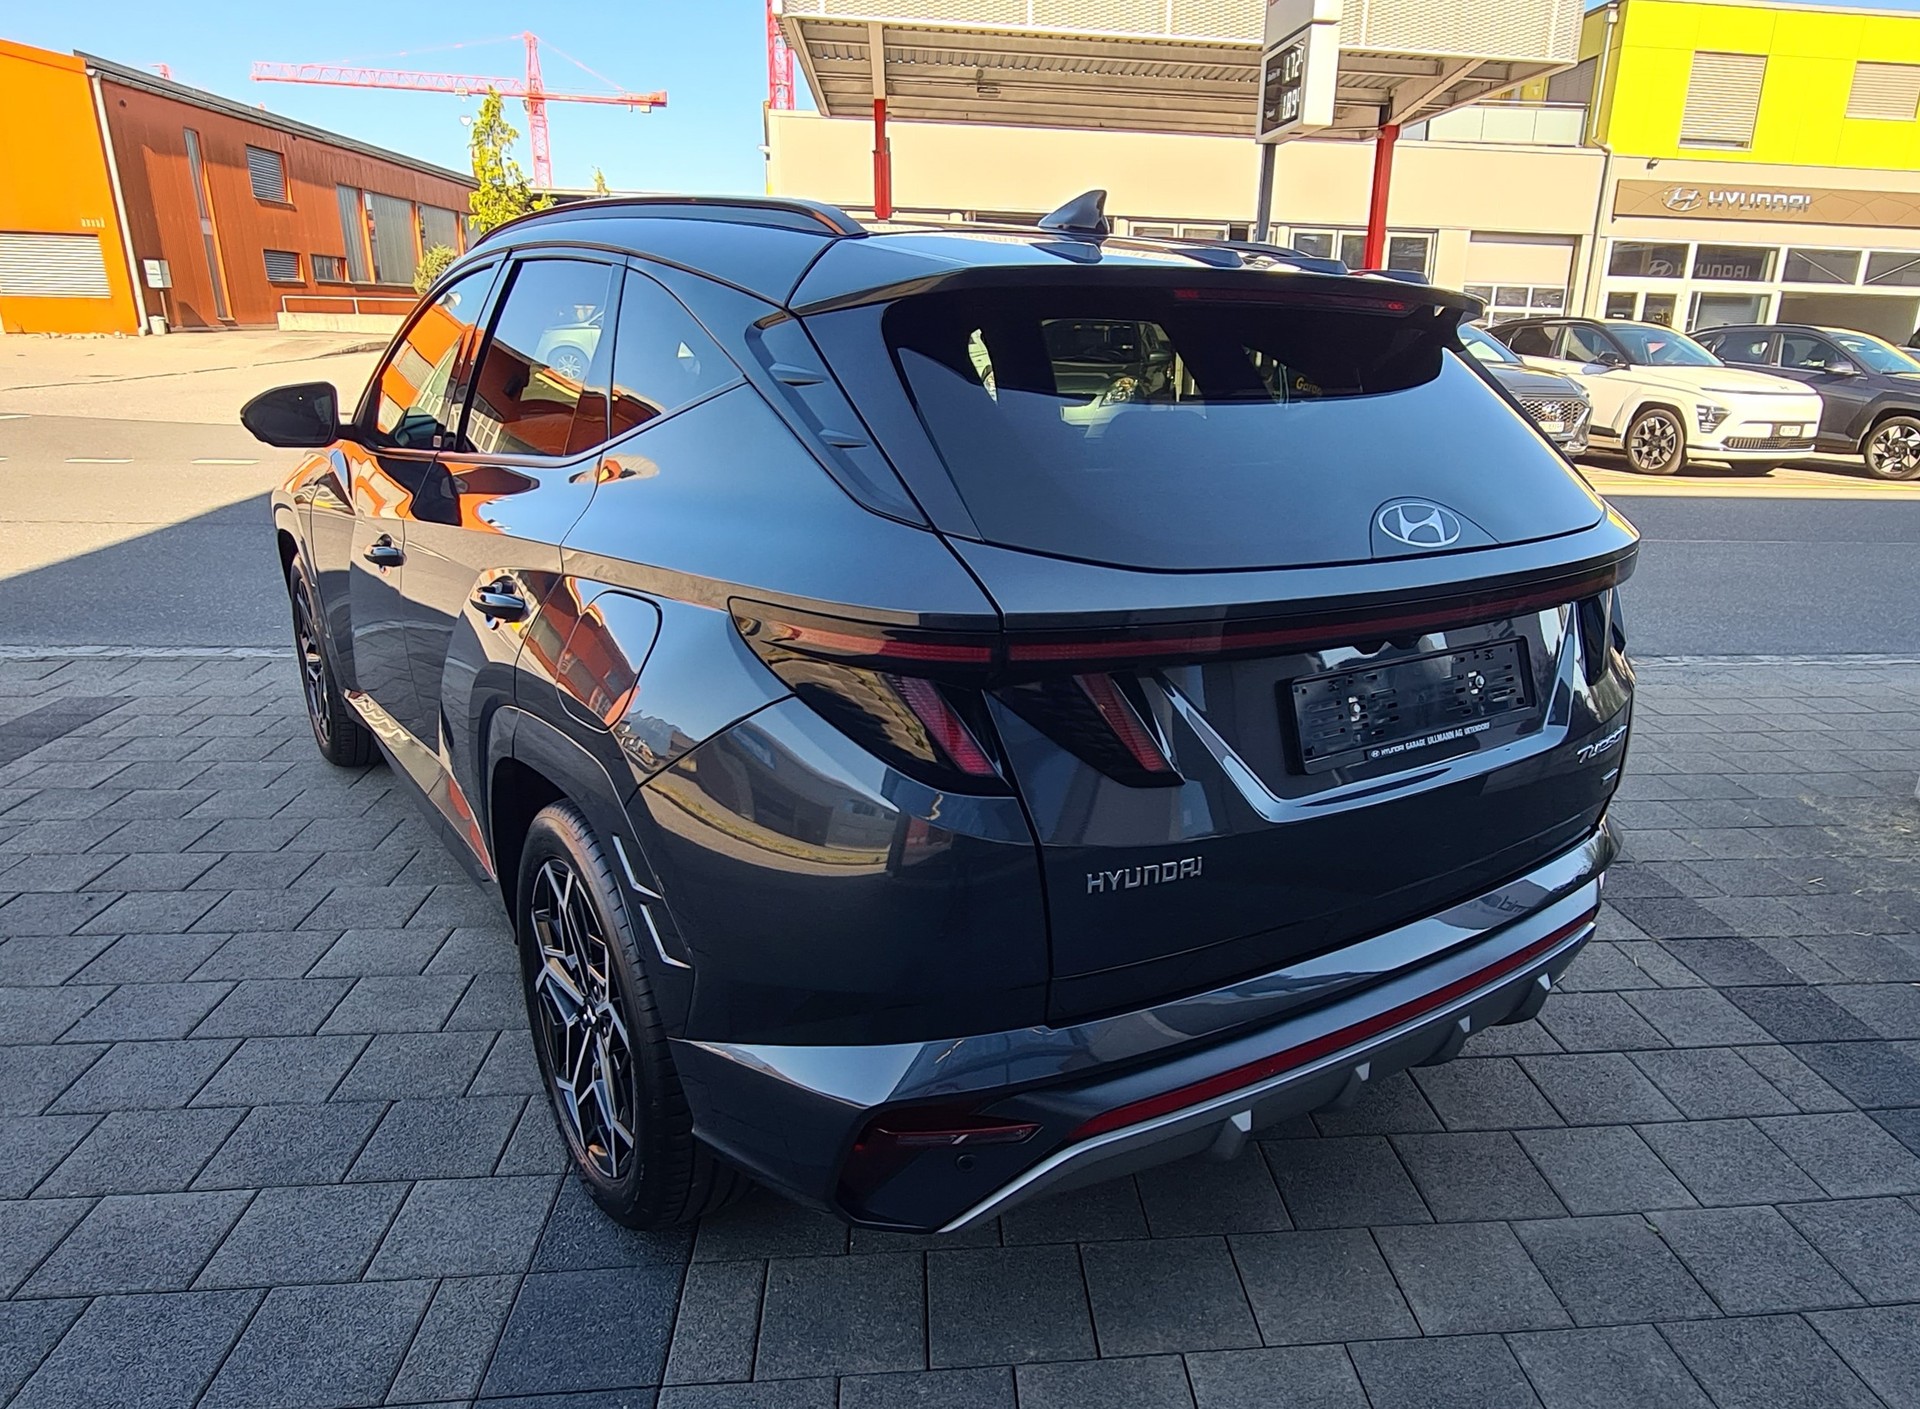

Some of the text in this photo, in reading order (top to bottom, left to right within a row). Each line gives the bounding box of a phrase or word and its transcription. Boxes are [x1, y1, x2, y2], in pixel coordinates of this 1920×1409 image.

[1707, 191, 1811, 212] HYUNDAI
[1405, 738, 1426, 750] GARAGE
[1427, 730, 1455, 745] ULLMANN
[1455, 728, 1464, 738] AG
[1086, 856, 1203, 894] HYUNDAI
